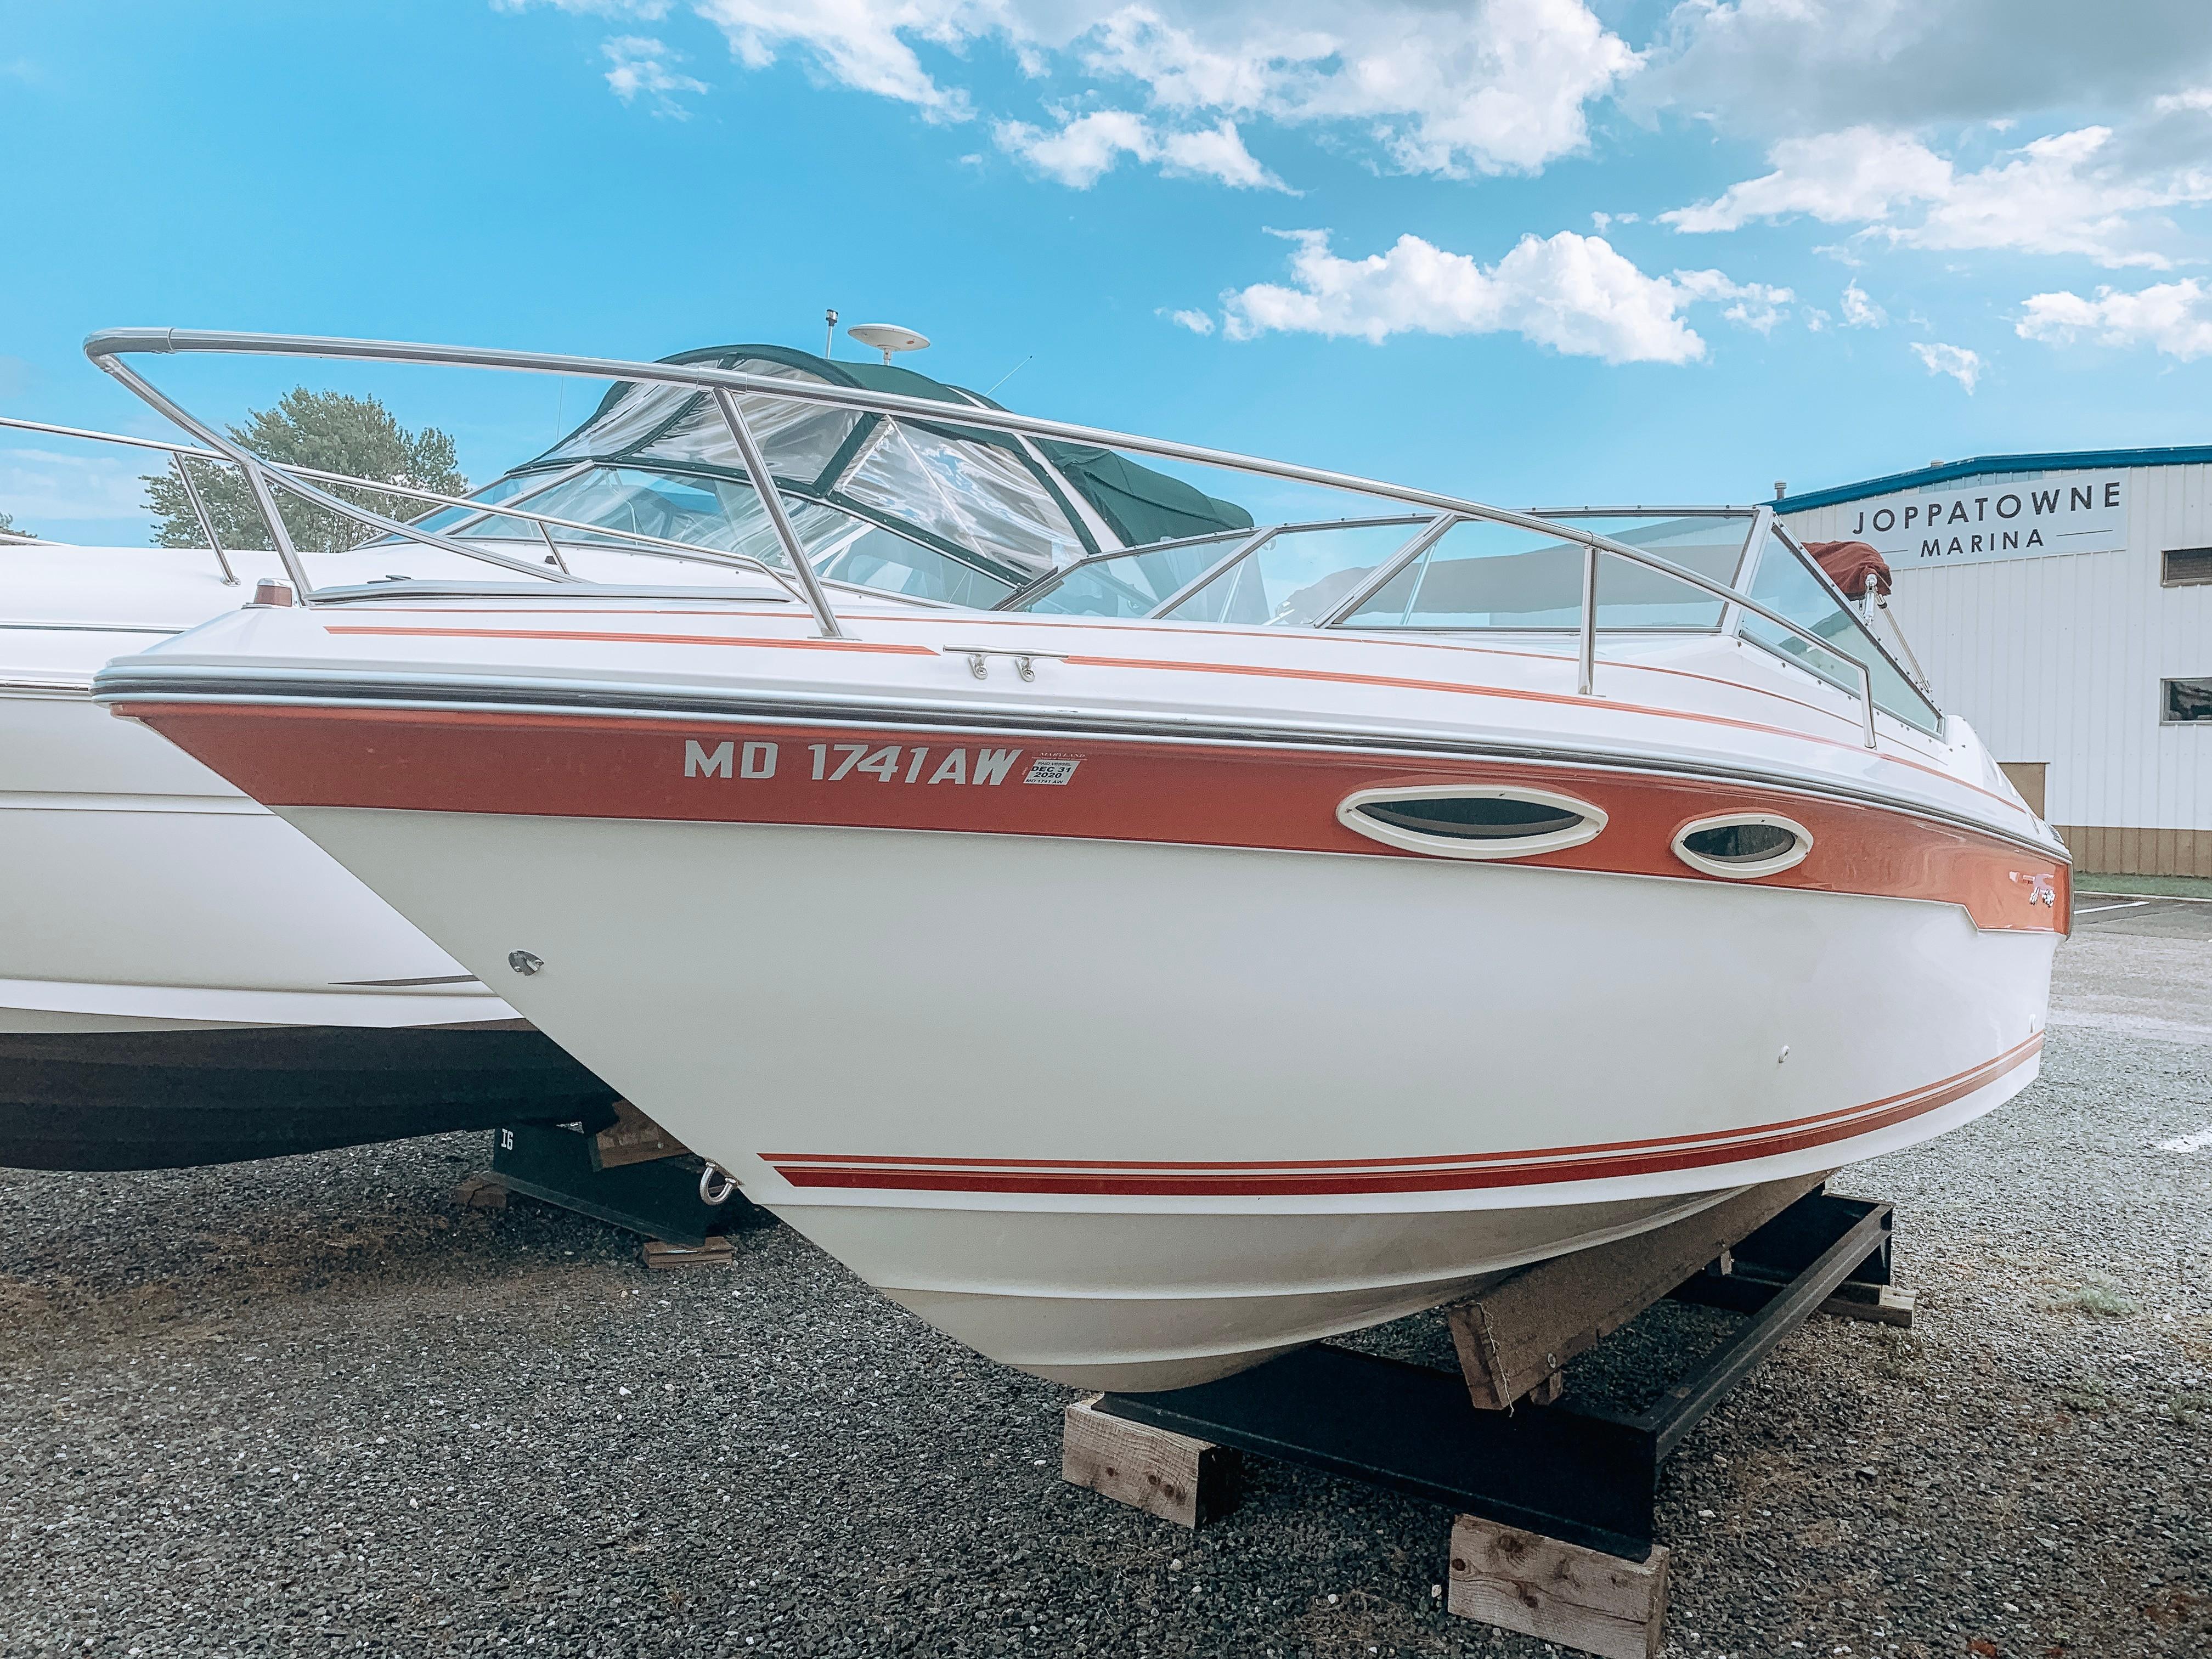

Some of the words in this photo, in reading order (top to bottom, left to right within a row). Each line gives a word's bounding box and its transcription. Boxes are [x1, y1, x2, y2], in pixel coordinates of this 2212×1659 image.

[1852, 482, 2120, 534] JOPPATOWNE
[1920, 529, 2044, 557] MARINA
[684, 740, 779, 779] MD
